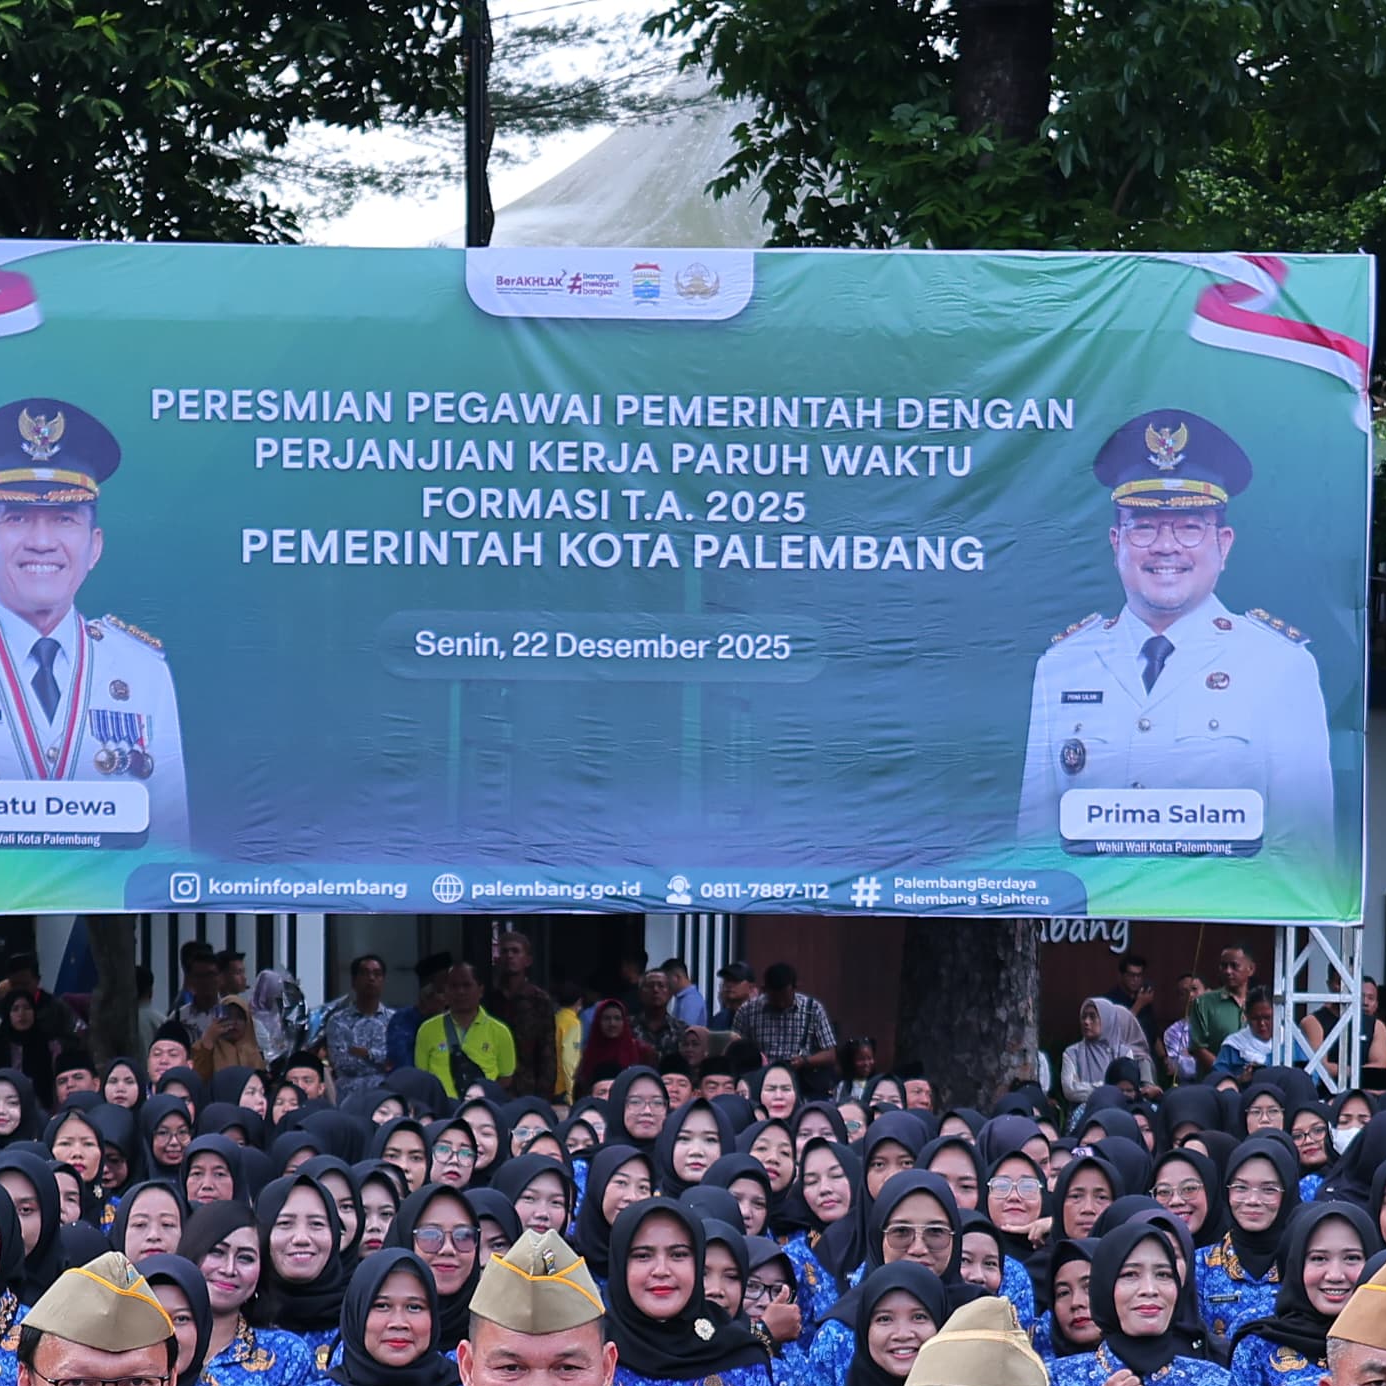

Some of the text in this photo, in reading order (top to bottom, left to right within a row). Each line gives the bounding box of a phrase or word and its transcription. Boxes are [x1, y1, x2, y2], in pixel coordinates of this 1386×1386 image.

[496, 275, 564, 288] BerAKHLAK
[152, 389, 1073, 430] PERESMIAN PEGAWAI PEMERINTAH DENGAN
[257, 438, 970, 476] PERJANJIAN KERJA PARUH WAKTU
[424, 487, 805, 522] FORMASI T.A. 2025
[243, 529, 983, 570] PEMERINTAH KOTA PALEMBANG
[416, 631, 792, 659] Senin, 22 Desember 2025
[46, 797, 115, 815] Dewa
[1088, 803, 1245, 823] Prima Salam
[18, 832, 41, 845] Kota
[44, 832, 101, 848] Palembang
[1096, 841, 1232, 855] Wakil Wali Kota Palembang
[209, 878, 407, 898] kominfopalembang
[472, 880, 641, 900] palembang.go.id
[701, 882, 829, 900] 0811-7887-112
[895, 877, 1036, 892] PalembangBerdaya
[895, 892, 1048, 907] Palembang Sejahtera
